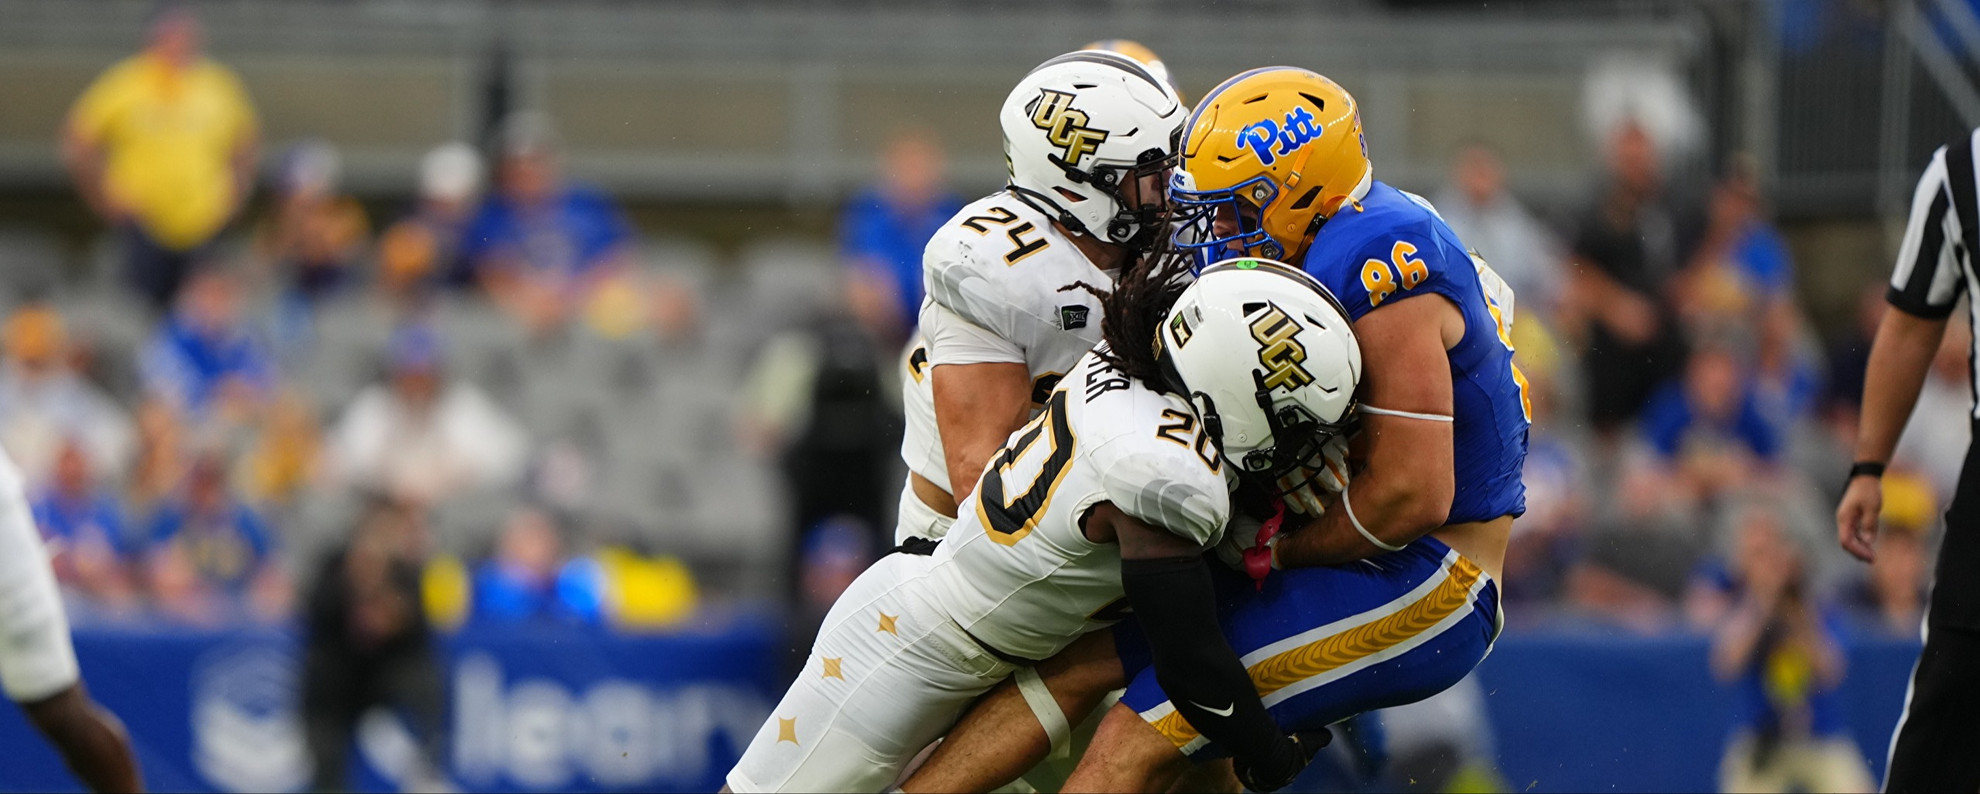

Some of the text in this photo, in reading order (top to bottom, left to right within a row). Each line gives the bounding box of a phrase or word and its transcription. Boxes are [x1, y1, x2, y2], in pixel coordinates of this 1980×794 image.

[1031, 87, 1110, 165] UCF
[1236, 106, 1323, 166] Pitt
[960, 206, 1050, 267] 24
[1361, 240, 1429, 307] 86
[1248, 298, 1316, 392] UCF
